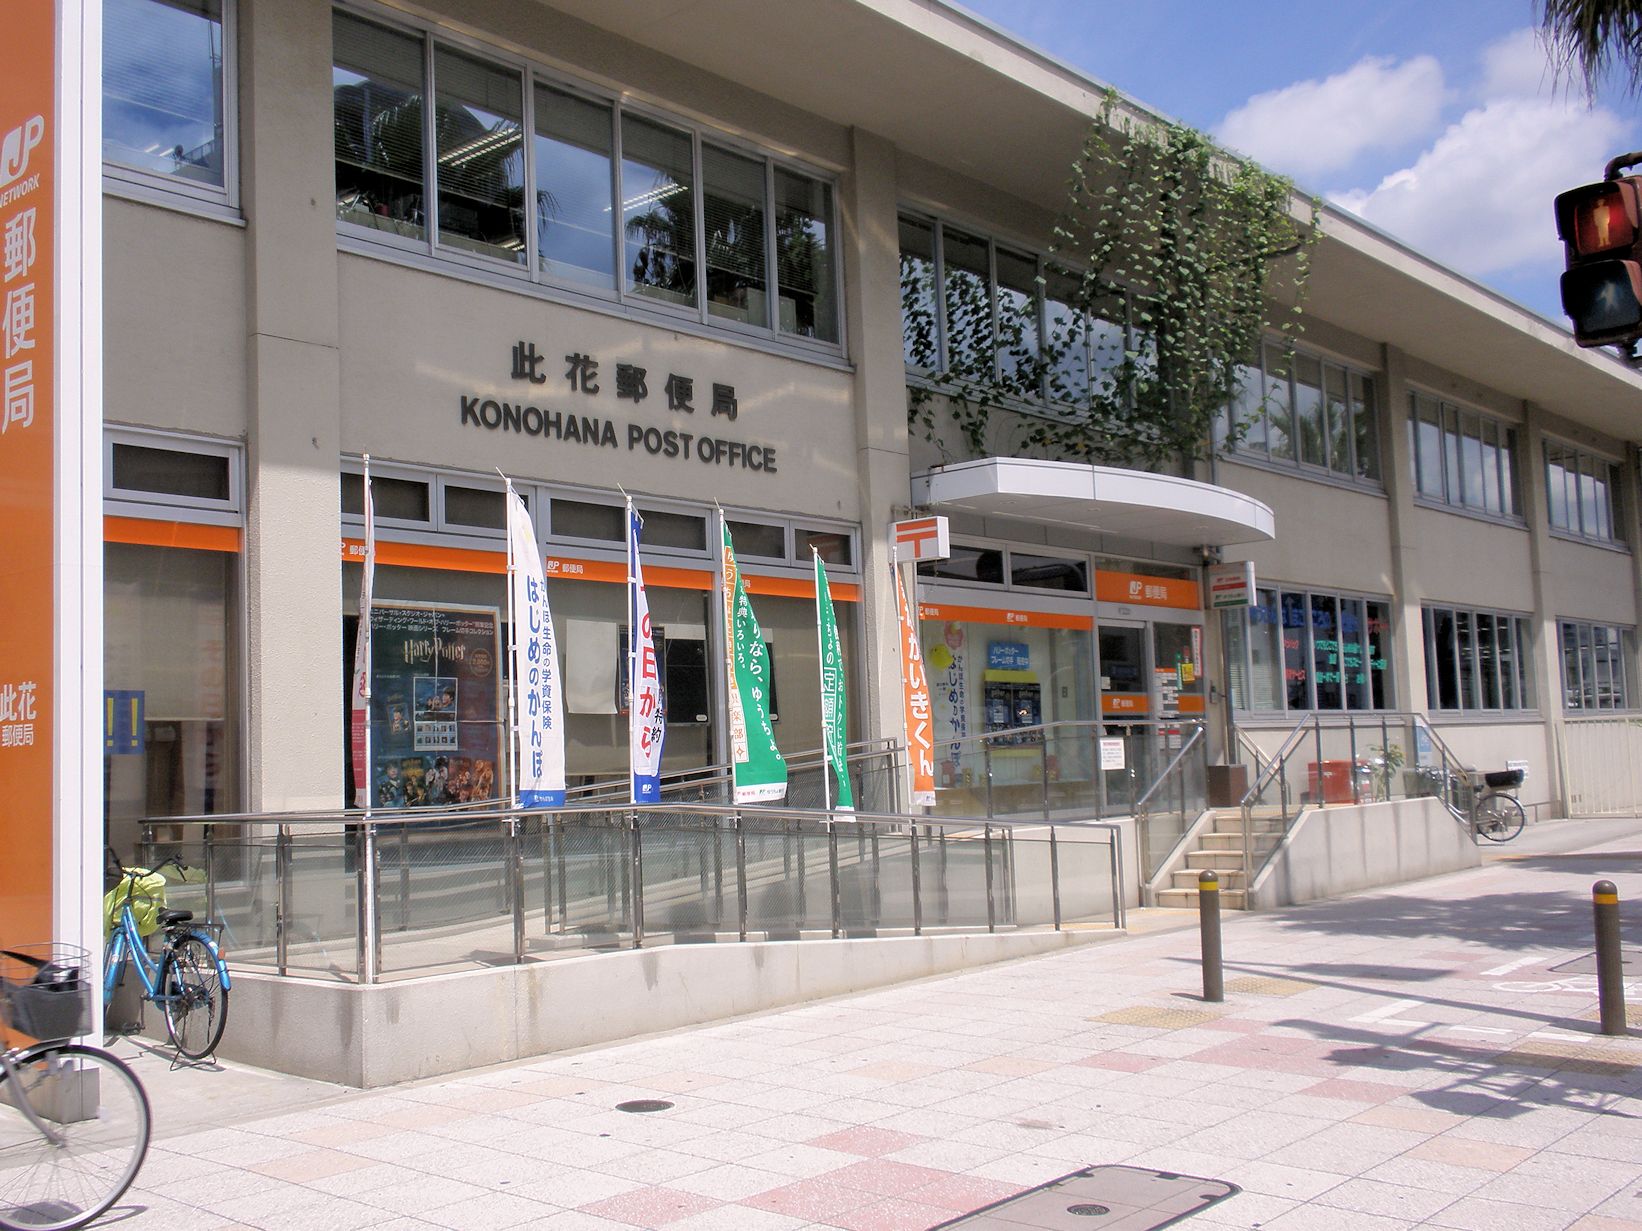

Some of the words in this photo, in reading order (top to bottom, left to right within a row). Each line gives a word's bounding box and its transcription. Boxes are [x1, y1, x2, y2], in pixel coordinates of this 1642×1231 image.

[2, 207, 36, 434] 郵便局
[510, 341, 738, 421] 此花郵便局
[461, 396, 618, 448] KONOHANA
[628, 423, 693, 459] POST
[697, 437, 777, 473] OFFICE
[404, 639, 434, 665] Harry
[527, 575, 543, 778] はじめのかんぽ
[0, 681, 37, 720] 此花
[2, 723, 34, 748] 郵便局
